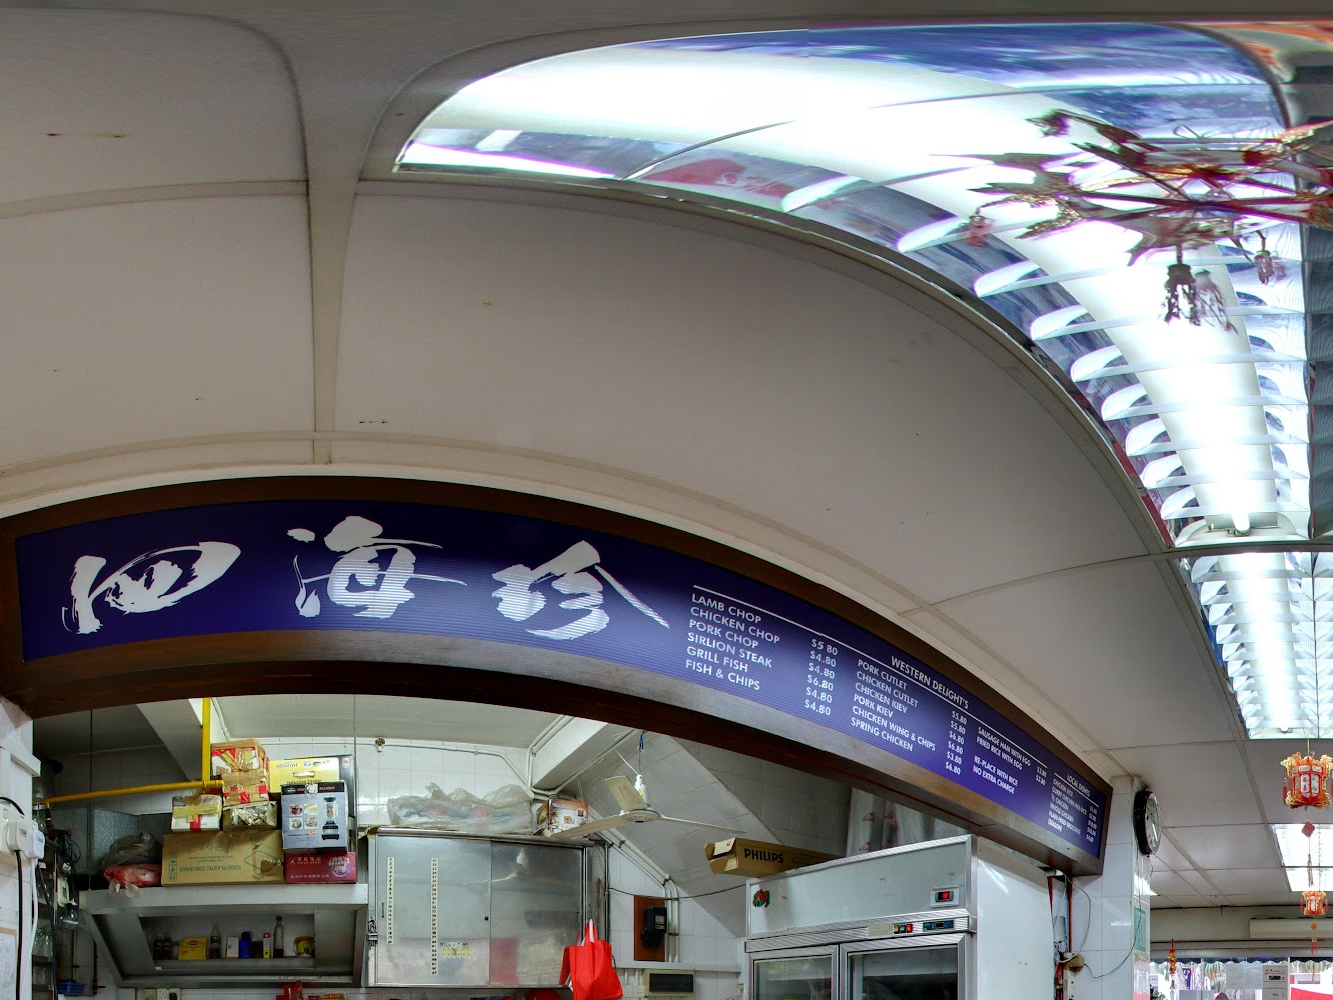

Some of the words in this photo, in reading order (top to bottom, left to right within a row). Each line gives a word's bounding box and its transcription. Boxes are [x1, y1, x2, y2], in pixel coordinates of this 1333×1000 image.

[692, 594, 724, 611] LAMB
[728, 606, 761, 623] CHOP
[689, 620, 721, 637] PORK
[725, 631, 758, 648] CHOP
[691, 607, 744, 631] CHICKEN
[749, 626, 780, 643] CHOP
[687, 647, 719, 664] GRILL
[723, 657, 748, 672] FISH
[688, 633, 735, 654] SIRLION
[739, 649, 772, 667] STEAK
[810, 651, 836, 667] $4.80
[686, 659, 712, 675] FISH
[716, 669, 723, 678] &
[728, 673, 760, 690] CHIPS
[807, 675, 833, 691] $6.80
[808, 663, 835, 679] $4.80
[858, 659, 878, 676] PORK
[881, 672, 907, 689] CUTLET
[892, 656, 930, 686] WESTERN
[933, 680, 969, 709] DELIGHT'S
[806, 687, 832, 703] $4.80
[855, 682, 890, 704] CHICKEN
[892, 700, 907, 713] KIEV
[857, 671, 891, 694] CHICKEN
[894, 690, 918, 707] CUTLET
[805, 700, 831, 715] $4.80
[854, 694, 875, 710] PORK
[877, 705, 893, 718] KIEV
[851, 718, 879, 736] SPRING
[882, 731, 913, 752] CHICKEN
[853, 706, 887, 728] CHICKEN
[890, 722, 909, 738] WING
[911, 733, 915, 741] &
[918, 736, 935, 751] CHIPS
[977, 736, 990, 750] FRIED
[991, 745, 1001, 757] RICE
[1002, 752, 1013, 764] WITH
[1013, 760, 1022, 770] EGG
[978, 727, 1000, 745] SAUSAGE
[1022, 757, 1031, 766] EGG
[973, 765, 981, 775] NO
[983, 772, 996, 784] EXTRA
[997, 779, 1015, 794] CHARGE
[974, 755, 996, 773] RE-PLACE
[997, 767, 1008, 780] WITH
[1009, 775, 1018, 786] RICE
[744, 847, 783, 864] PHILIPS
